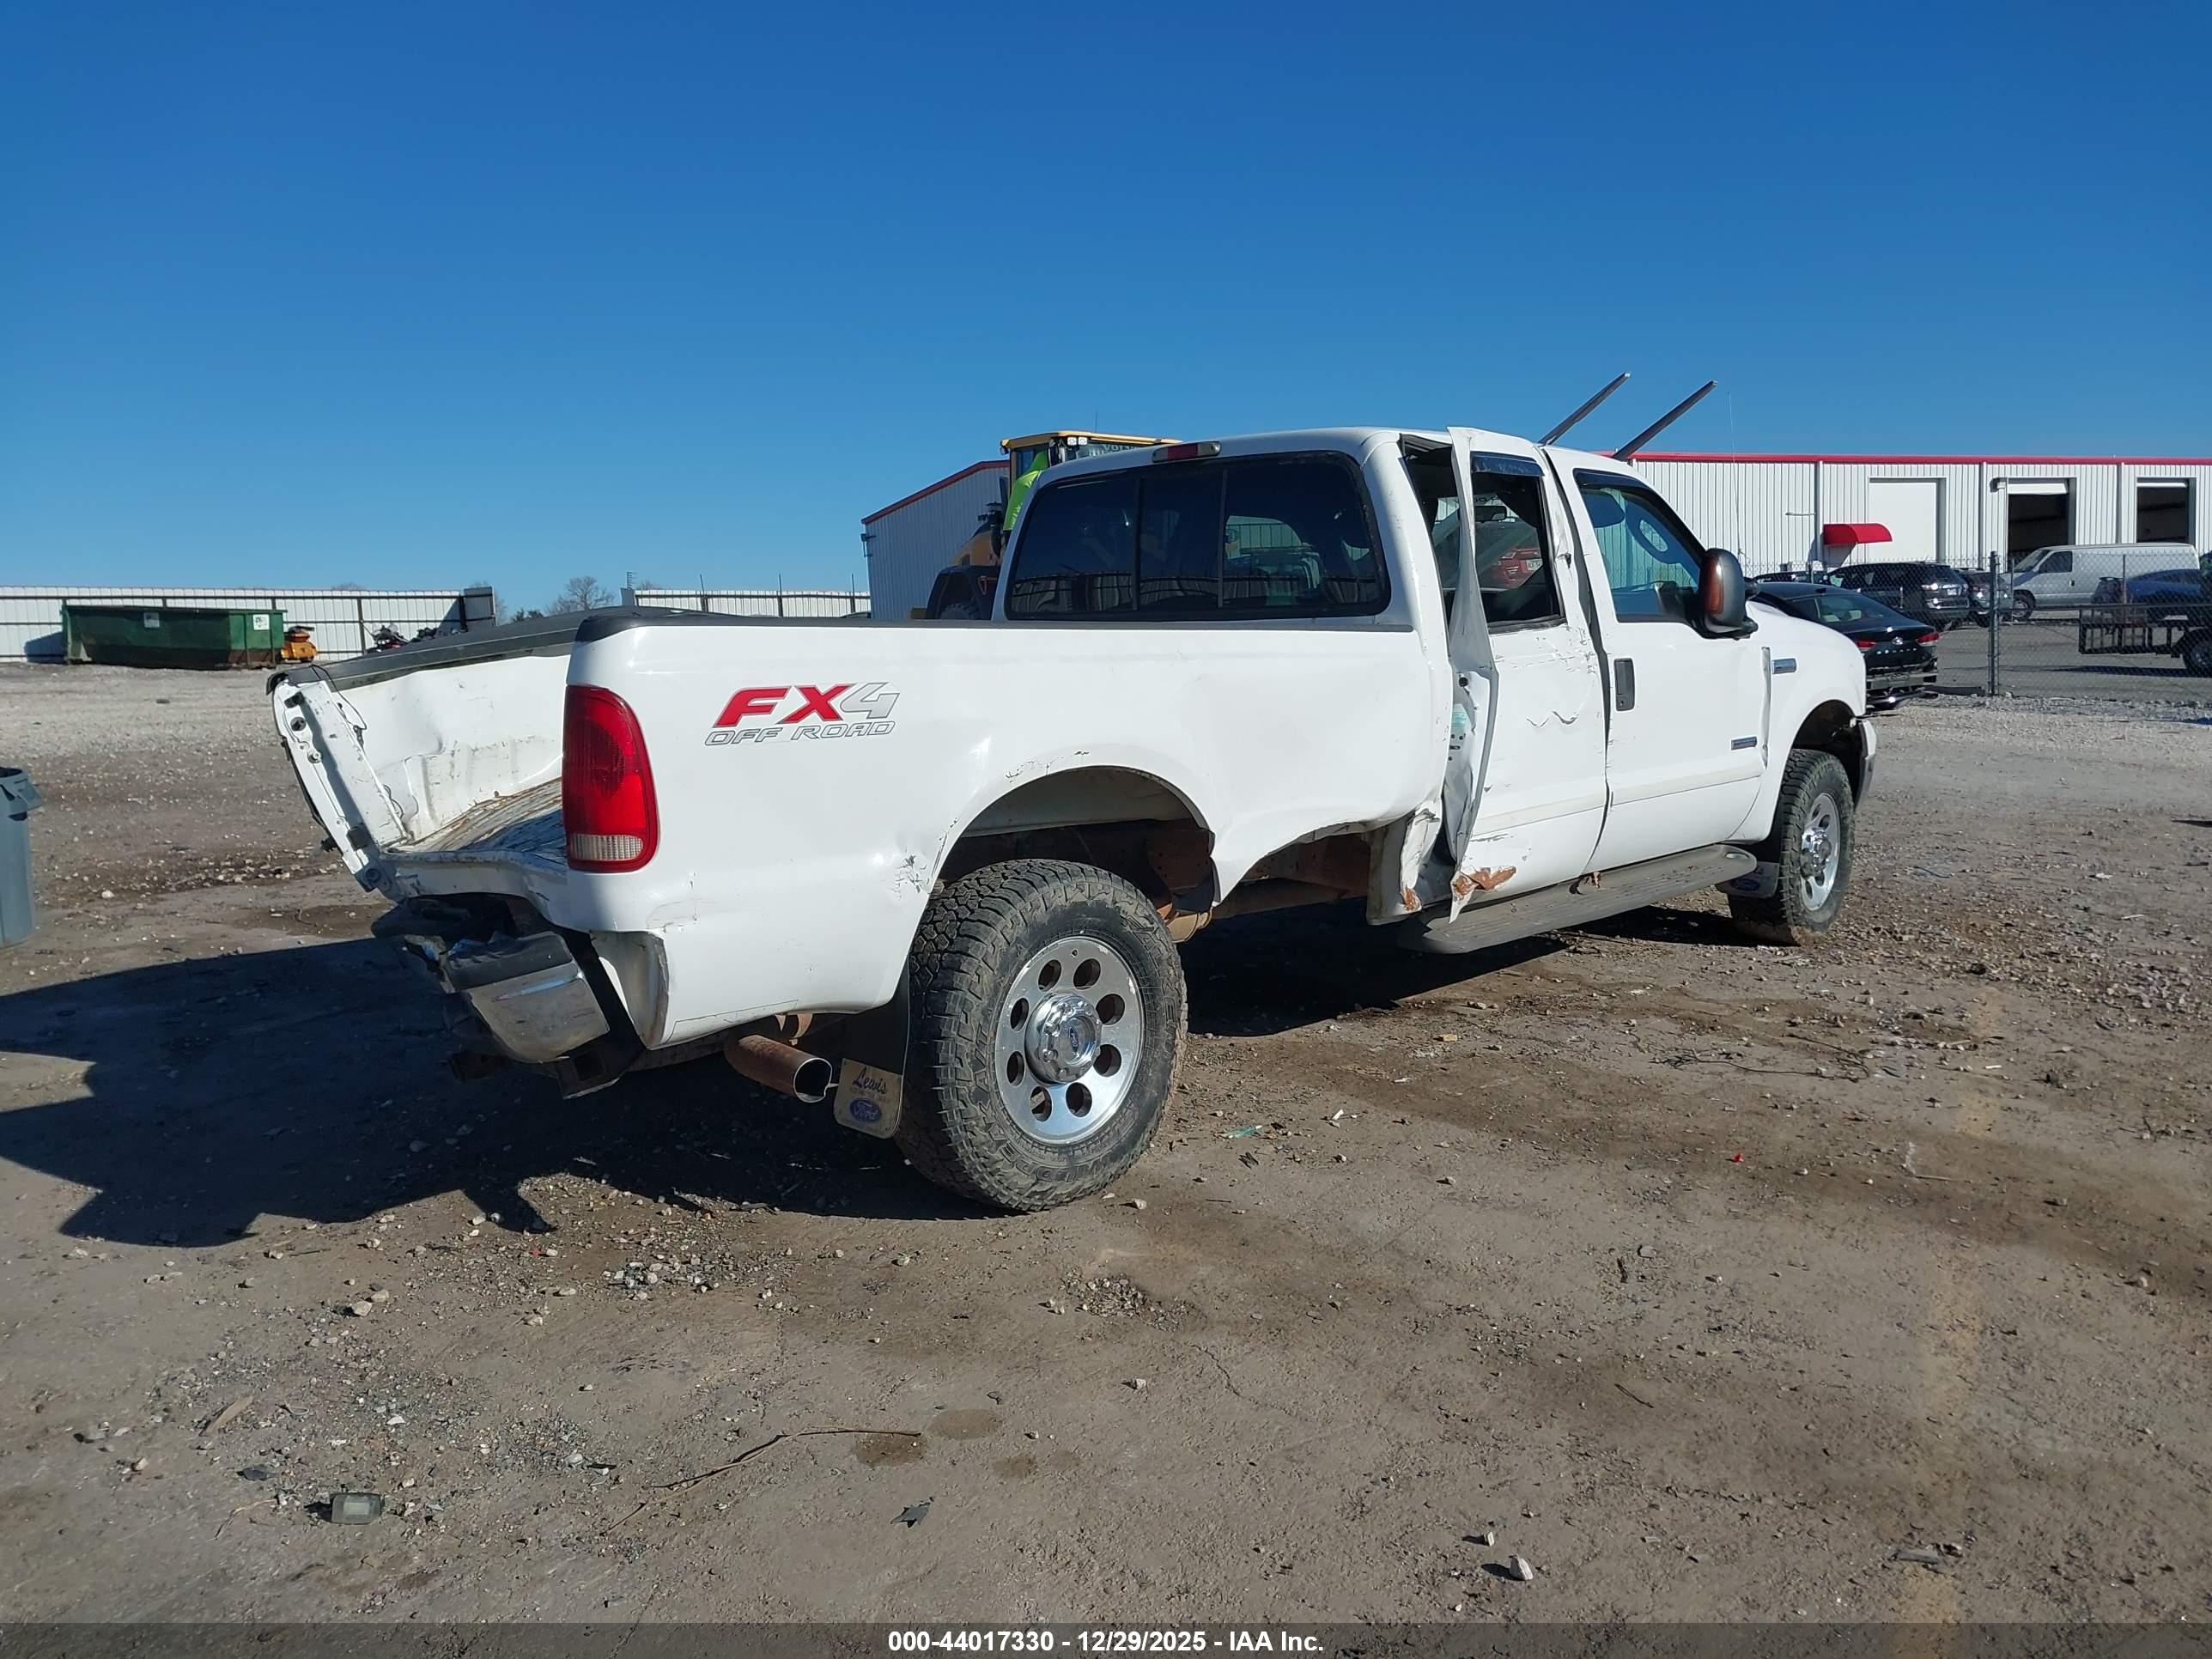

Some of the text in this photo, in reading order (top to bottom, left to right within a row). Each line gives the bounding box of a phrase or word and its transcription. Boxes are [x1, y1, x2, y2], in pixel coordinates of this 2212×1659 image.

[712, 682, 901, 728] FX4
[704, 720, 896, 746] OFF ROAD
[852, 1066, 888, 1094] Lewis
[853, 1100, 880, 1121] Ford
